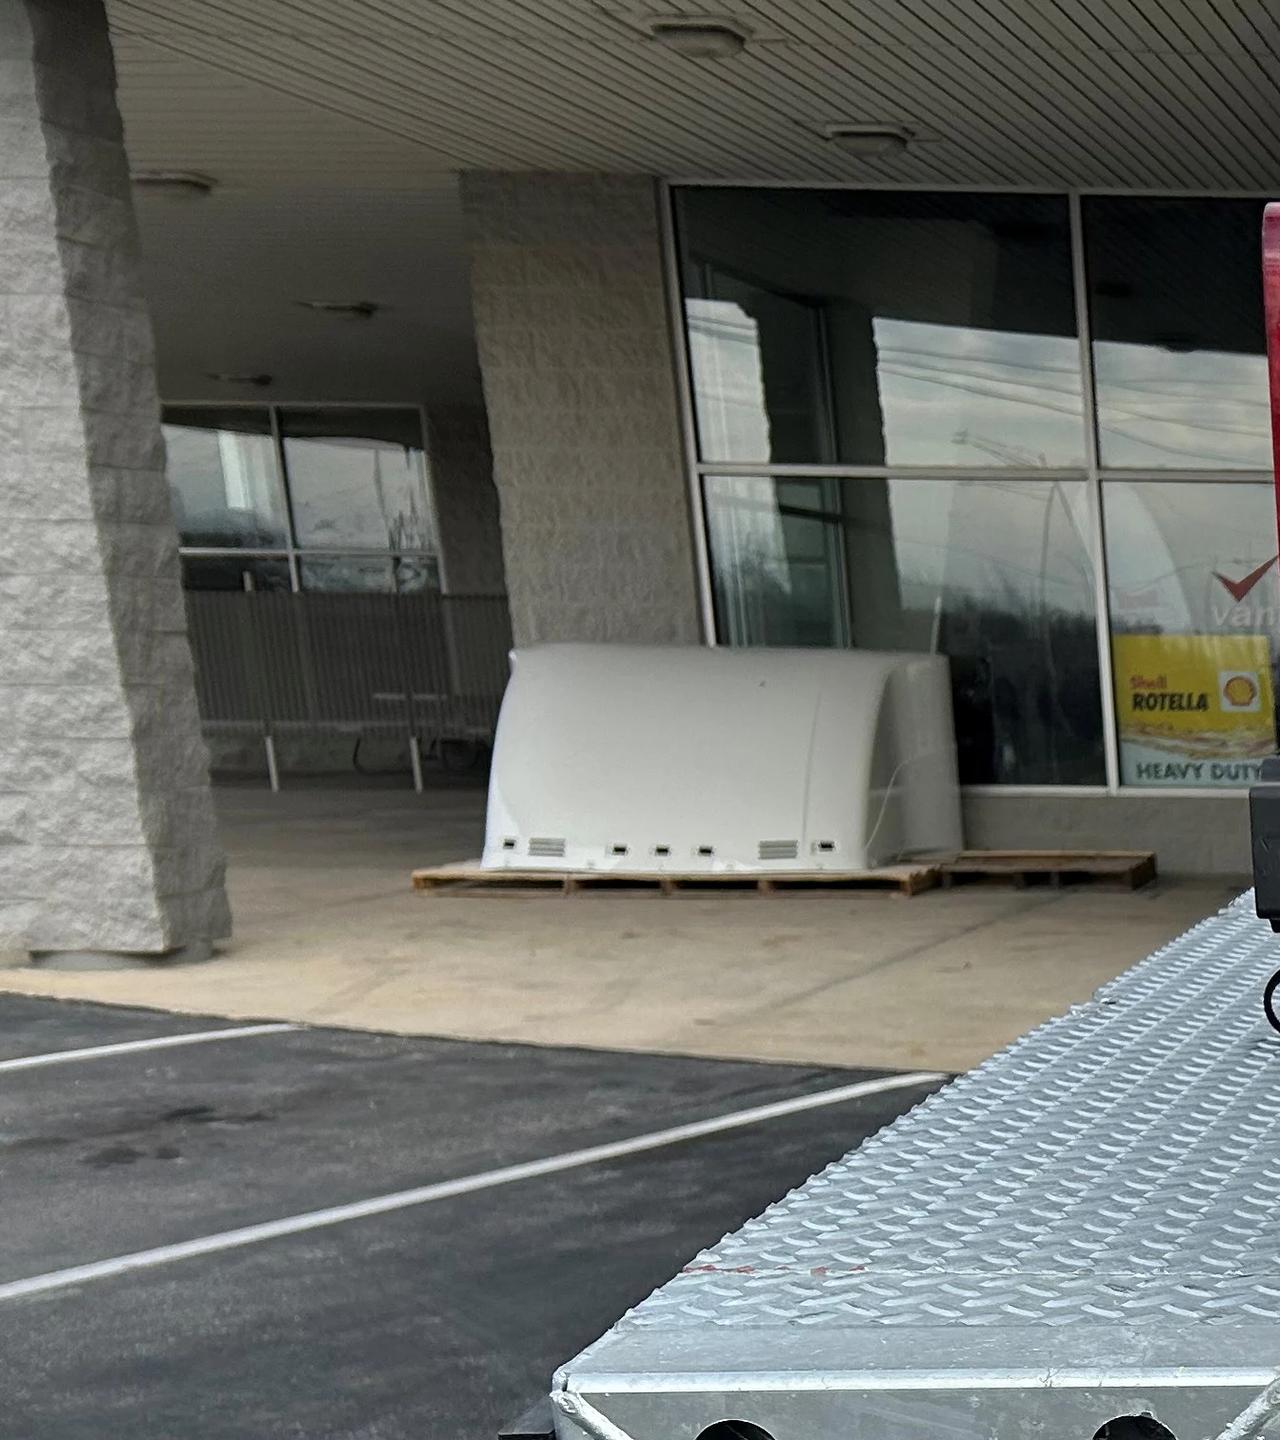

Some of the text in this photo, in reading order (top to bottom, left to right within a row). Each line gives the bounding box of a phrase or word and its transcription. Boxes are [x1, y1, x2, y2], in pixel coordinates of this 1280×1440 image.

[1130, 675, 1167, 689] Shell
[1132, 692, 1209, 711] ROTELLA
[1136, 762, 1261, 779] HEAVY DUTY
